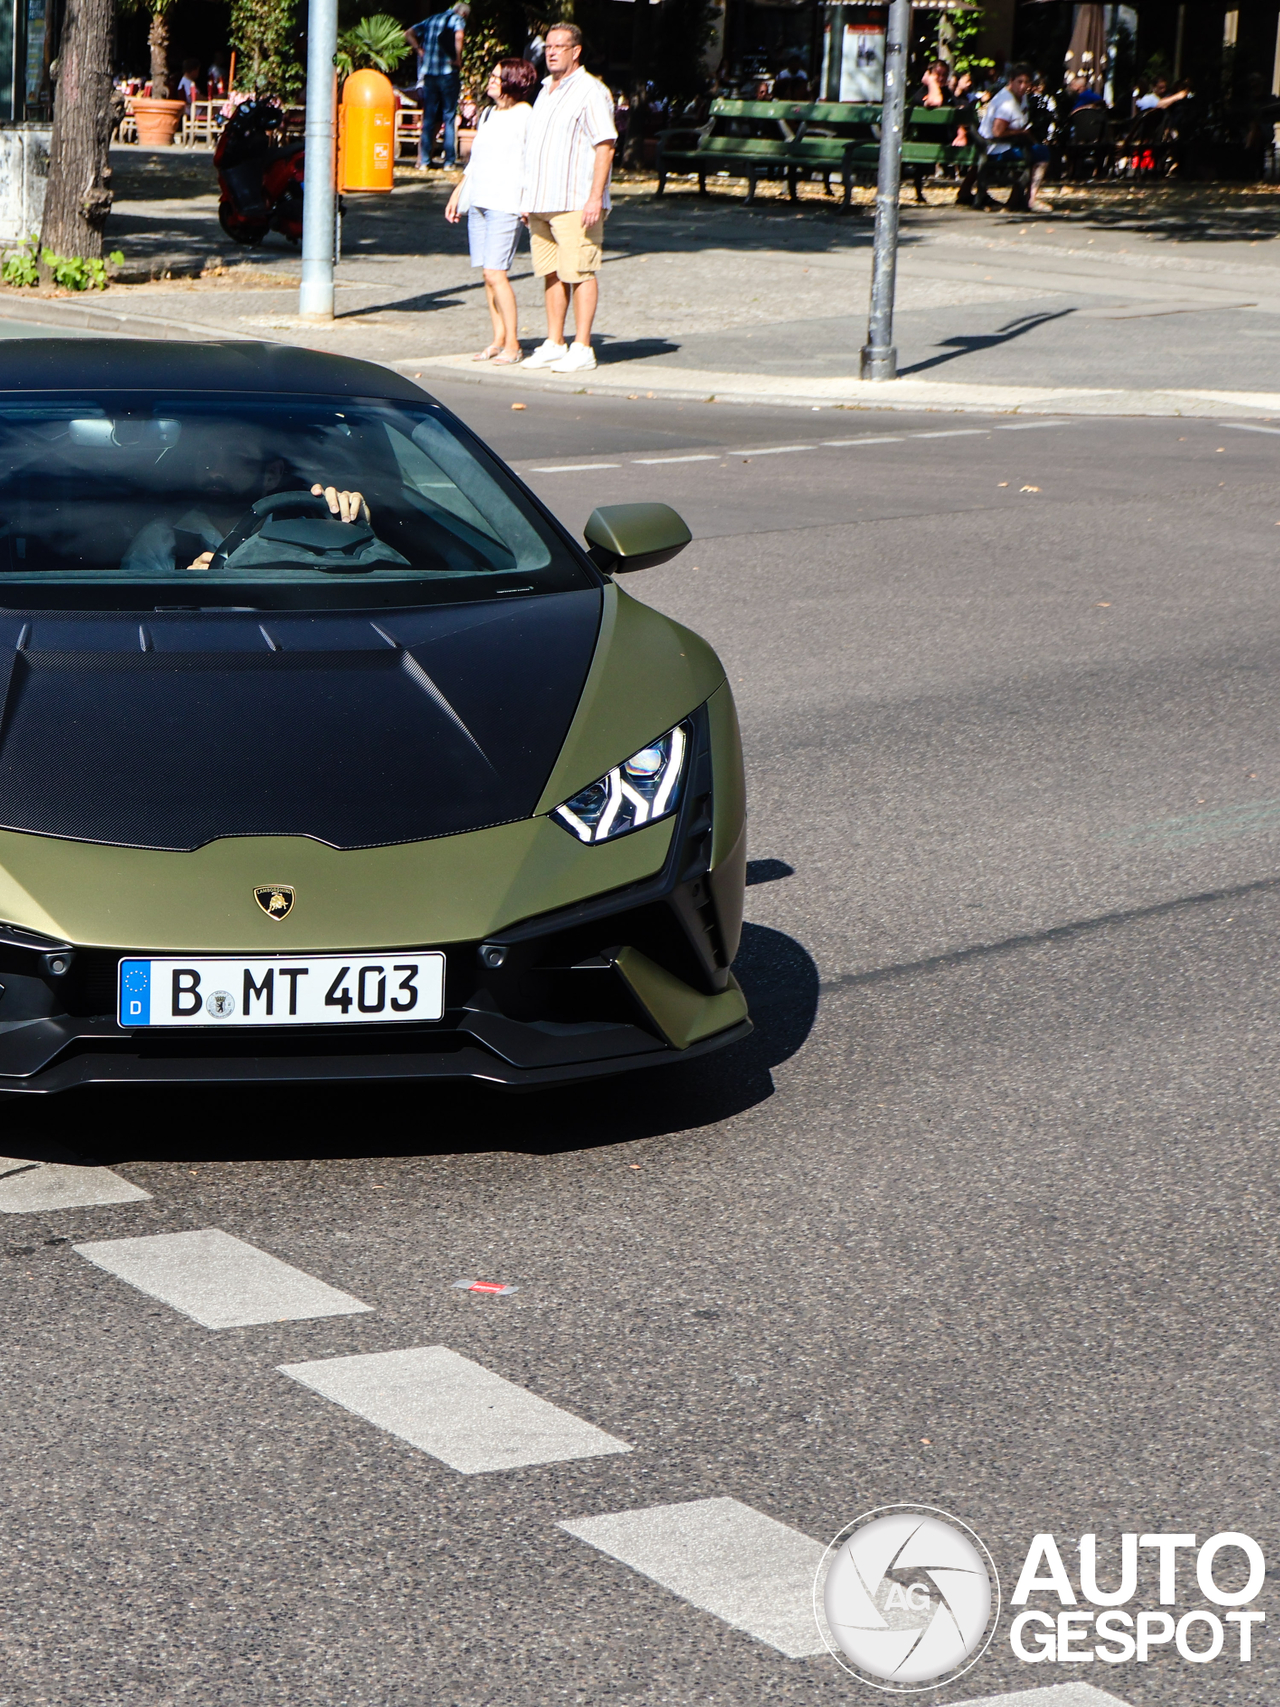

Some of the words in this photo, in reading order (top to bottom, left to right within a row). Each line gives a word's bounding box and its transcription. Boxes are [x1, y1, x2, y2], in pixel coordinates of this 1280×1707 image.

[172, 968, 203, 1017] B
[242, 967, 309, 1016] MT
[324, 964, 419, 1015] 403
[130, 1001, 141, 1015] D
